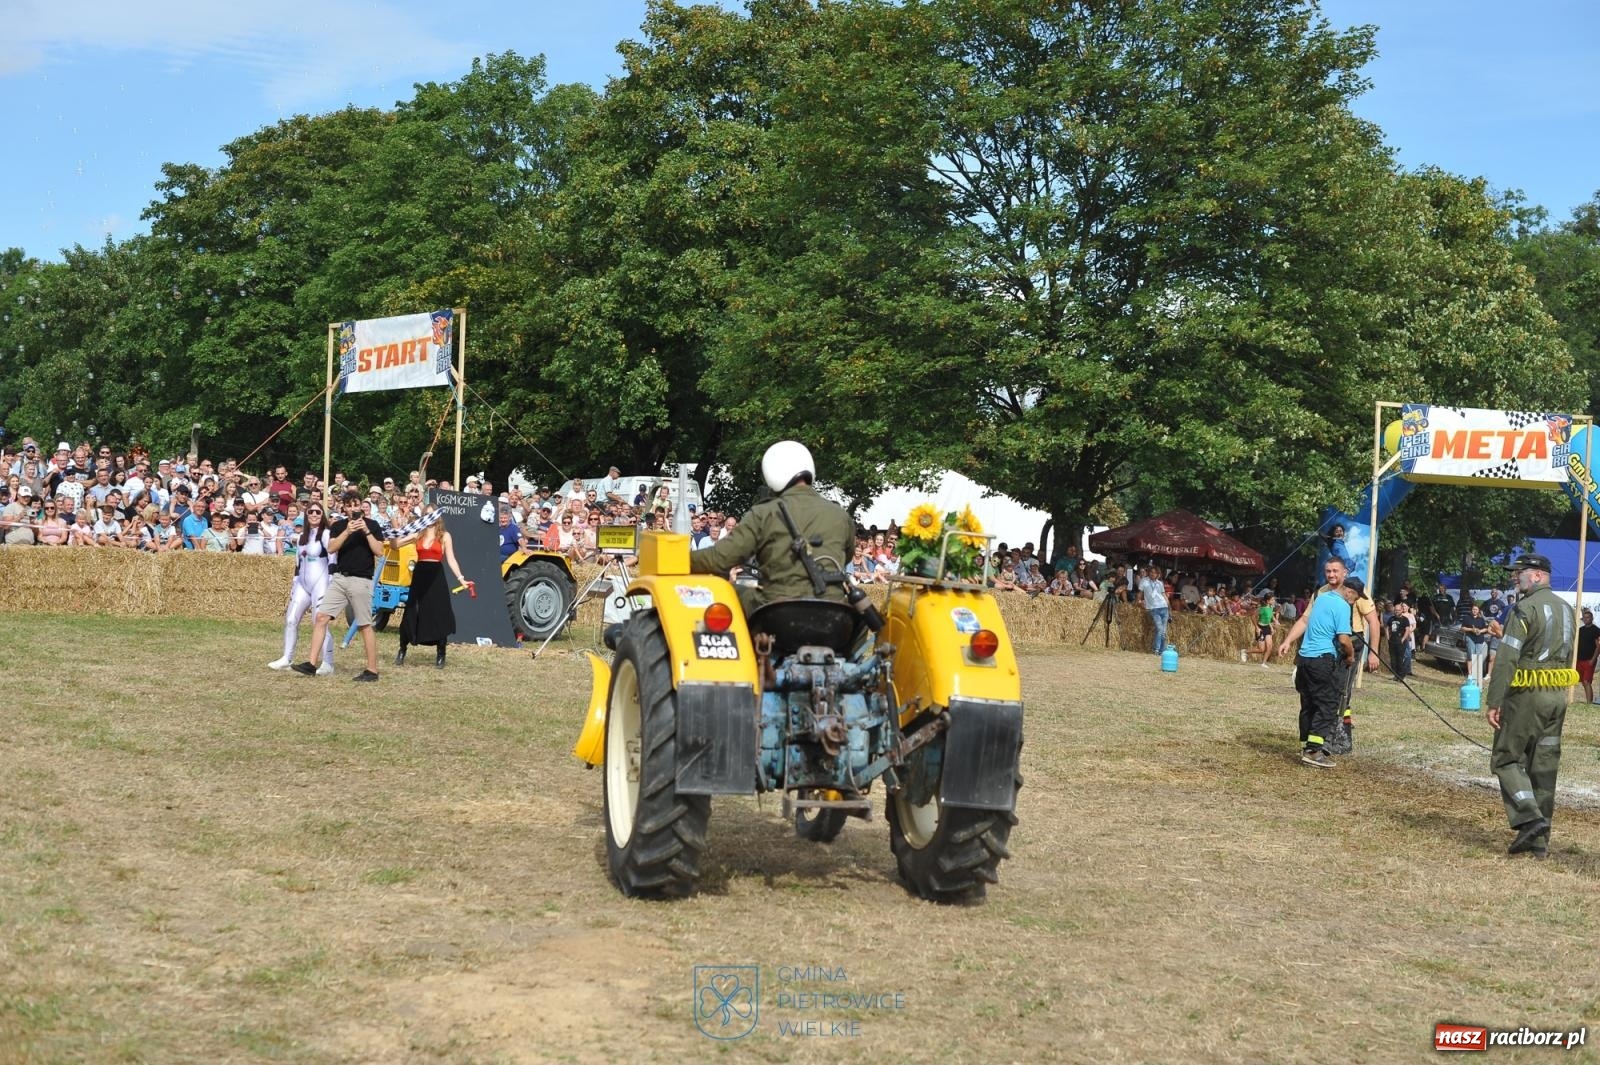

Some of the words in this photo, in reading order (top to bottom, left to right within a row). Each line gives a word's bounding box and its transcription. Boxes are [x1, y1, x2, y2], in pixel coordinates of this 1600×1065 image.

[358, 337, 431, 373] START
[1431, 430, 1548, 460] META
[436, 493, 478, 507] KOSMICZNE
[444, 506, 466, 516] YNIKI
[700, 634, 732, 647] KCA
